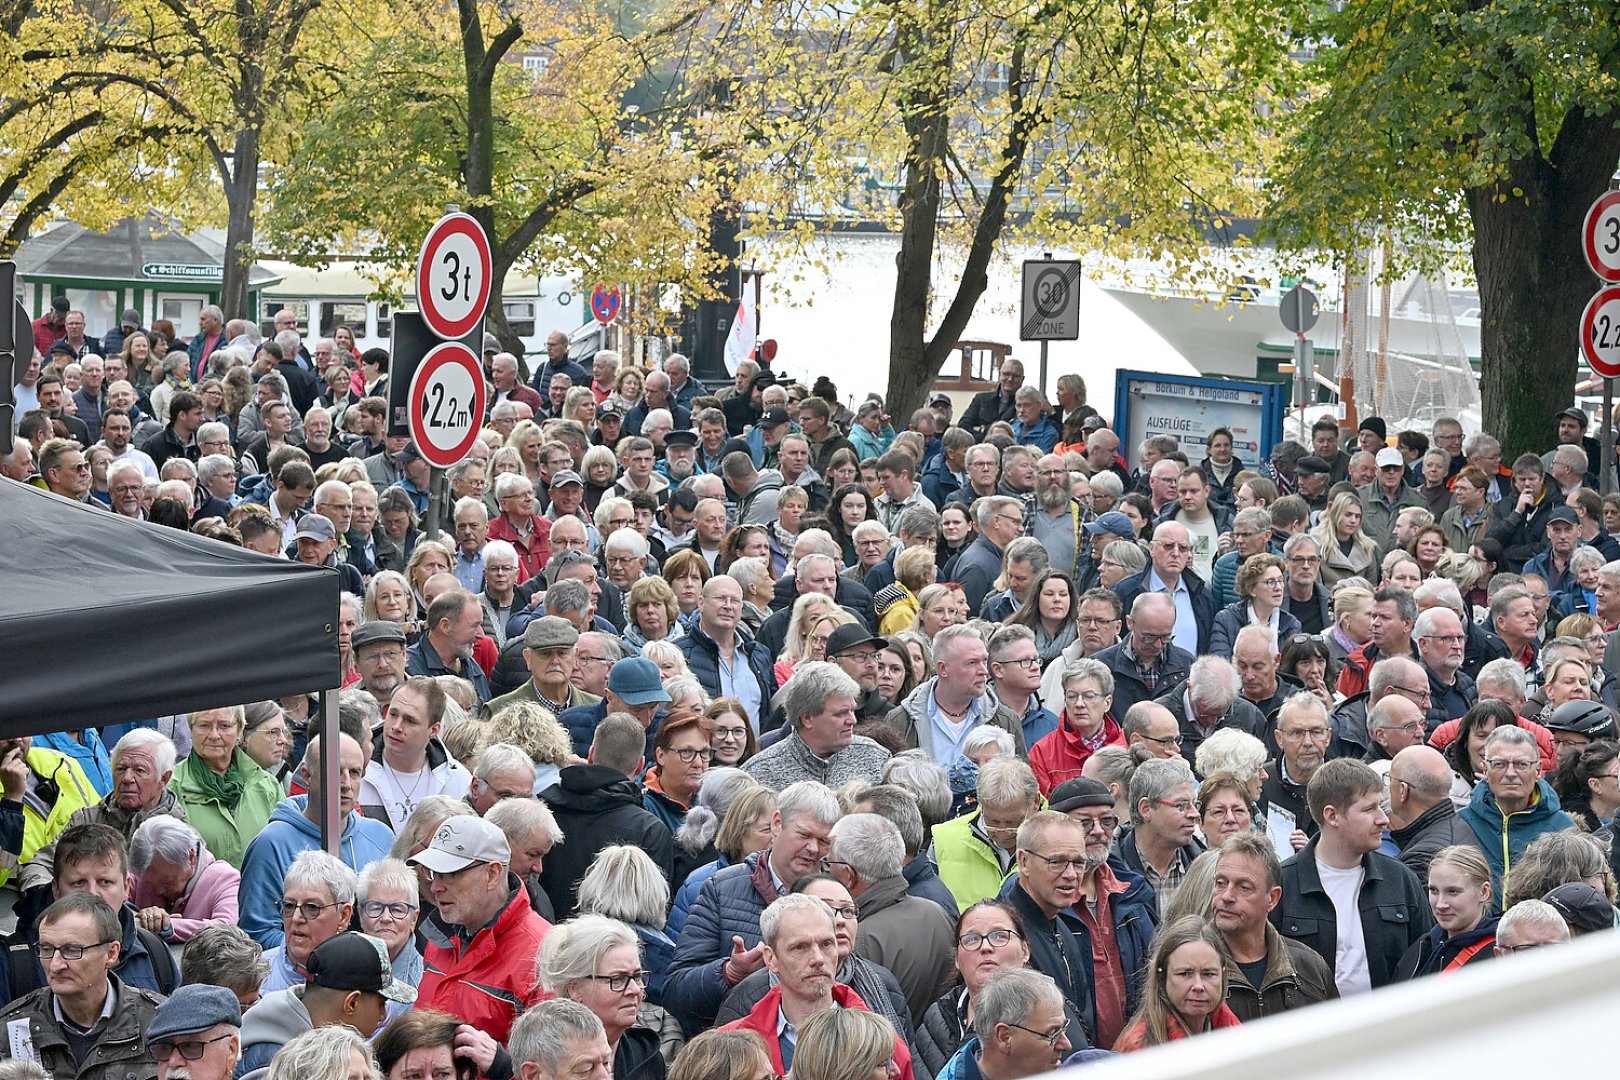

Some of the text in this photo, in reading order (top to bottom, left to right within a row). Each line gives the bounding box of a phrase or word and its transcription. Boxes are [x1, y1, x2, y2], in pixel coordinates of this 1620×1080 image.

[158, 265, 224, 277] Schiffsausflüg
[1040, 281, 1063, 304] 30
[1036, 322, 1065, 335] ZONE
[1155, 383, 1186, 396] Borkum
[1188, 387, 1195, 396] &
[1200, 387, 1240, 400] Helgoland
[1146, 416, 1192, 431] AUSFLÜGE
